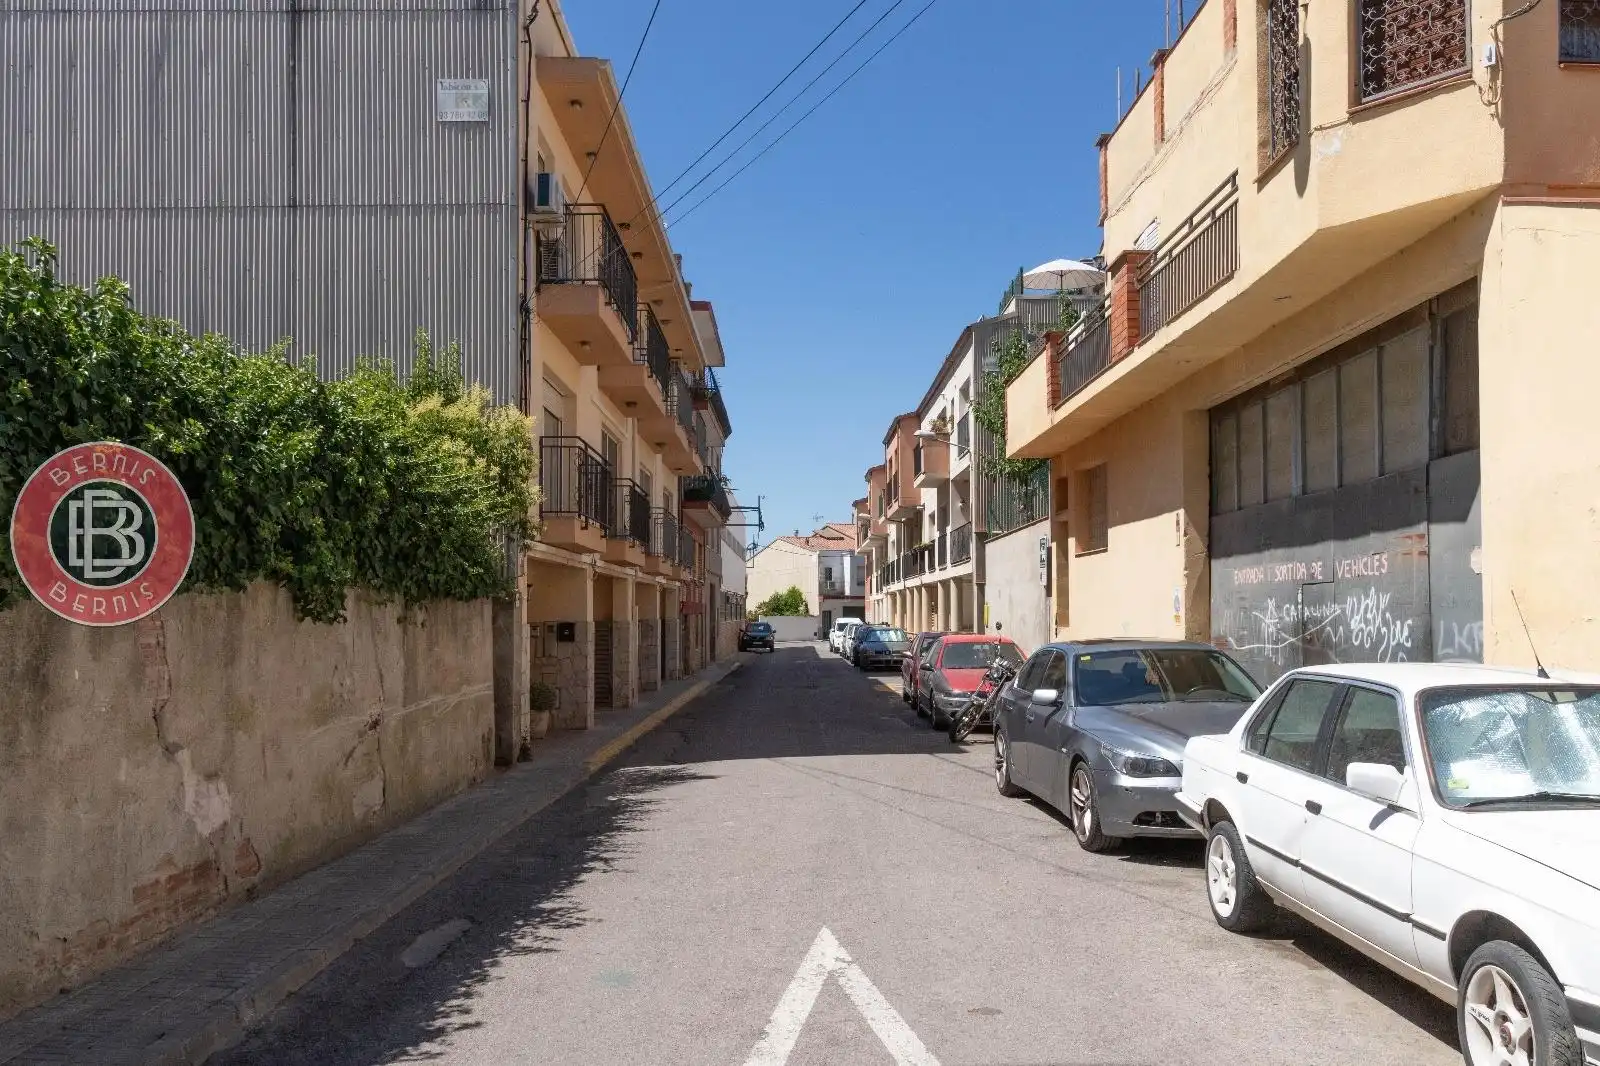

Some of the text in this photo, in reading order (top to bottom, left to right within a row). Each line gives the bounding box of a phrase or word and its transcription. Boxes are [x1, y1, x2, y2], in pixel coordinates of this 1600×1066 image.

[1234, 566, 1264, 585] ENTRADA
[1275, 560, 1306, 581] SORTIDA
[1311, 560, 1323, 580] DE
[1336, 554, 1388, 578] VEHICLES
